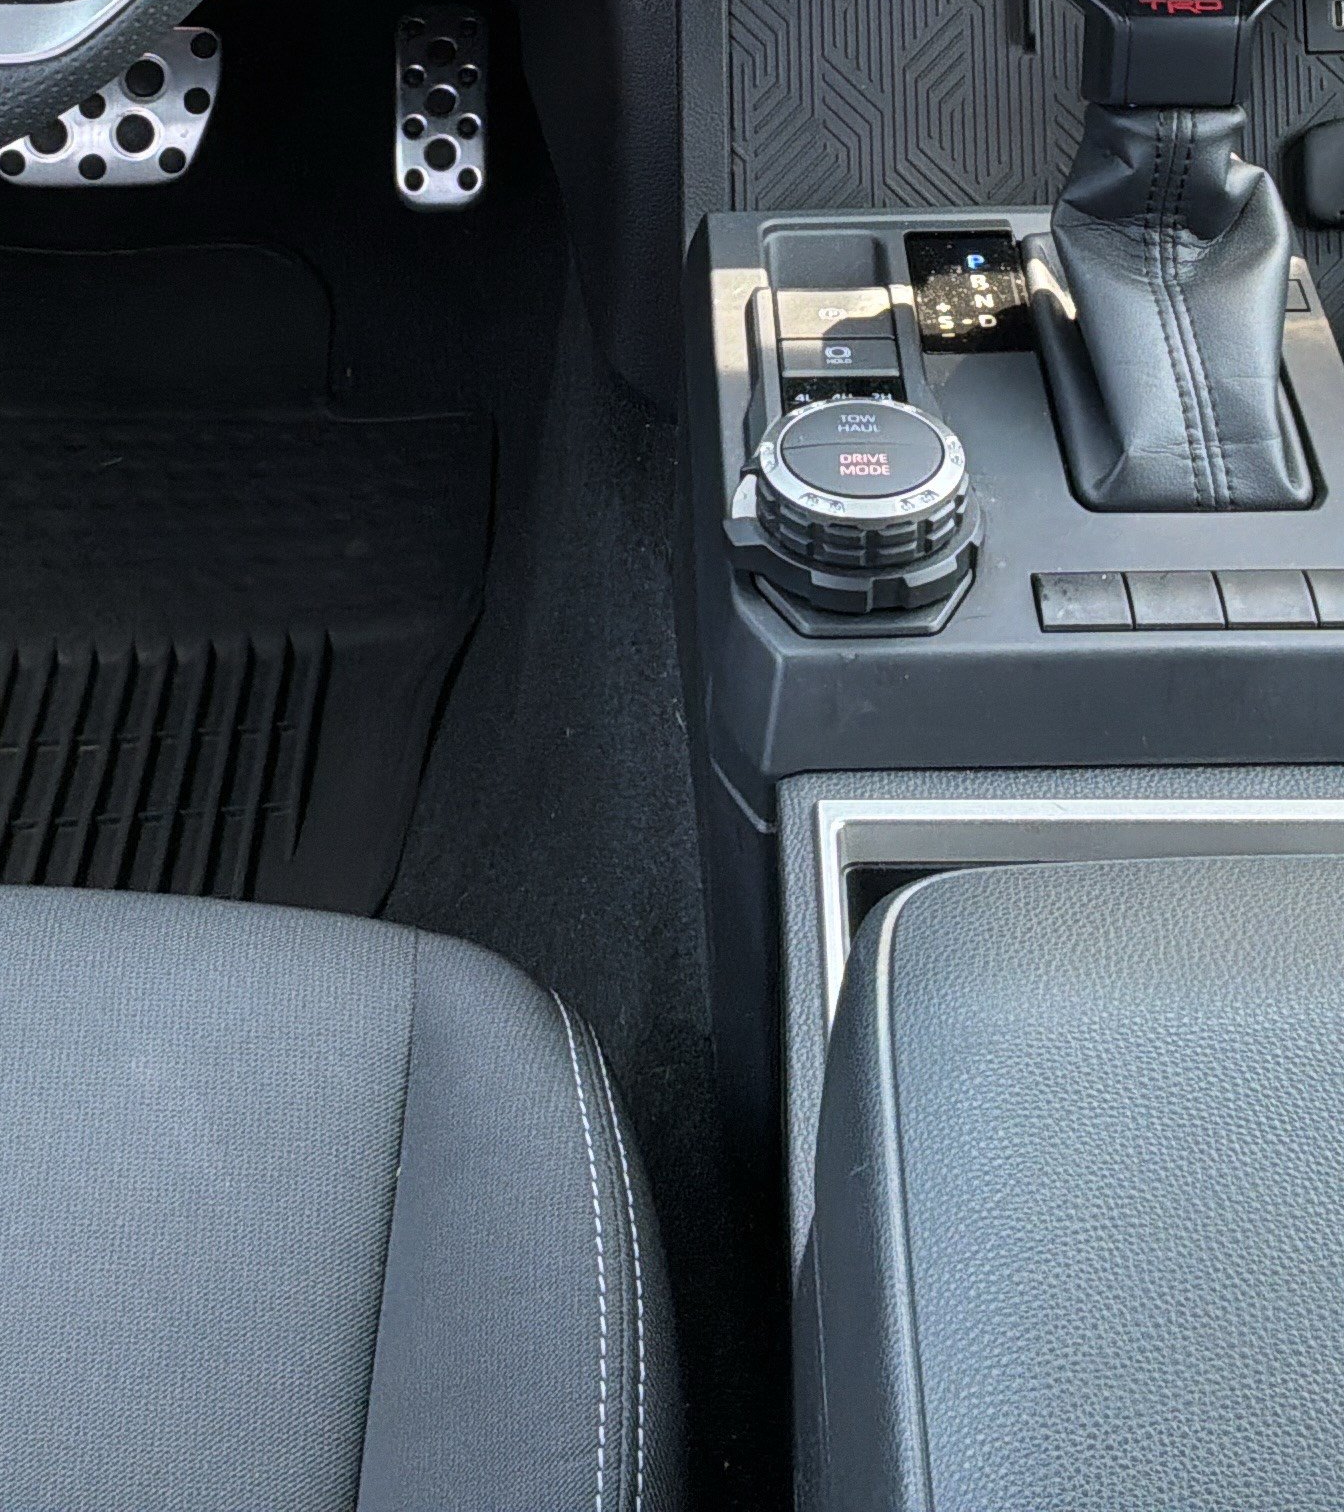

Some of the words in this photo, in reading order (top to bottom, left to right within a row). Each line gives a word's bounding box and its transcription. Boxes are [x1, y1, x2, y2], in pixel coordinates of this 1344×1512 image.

[966, 254, 986, 270] P
[969, 274, 990, 291] R
[973, 293, 995, 309] N
[937, 315, 955, 330] S
[977, 314, 998, 328] D
[839, 414, 877, 424] TOW
[837, 424, 882, 434] HAUL
[839, 453, 890, 465] DRIVE
[839, 465, 891, 477] MODE
